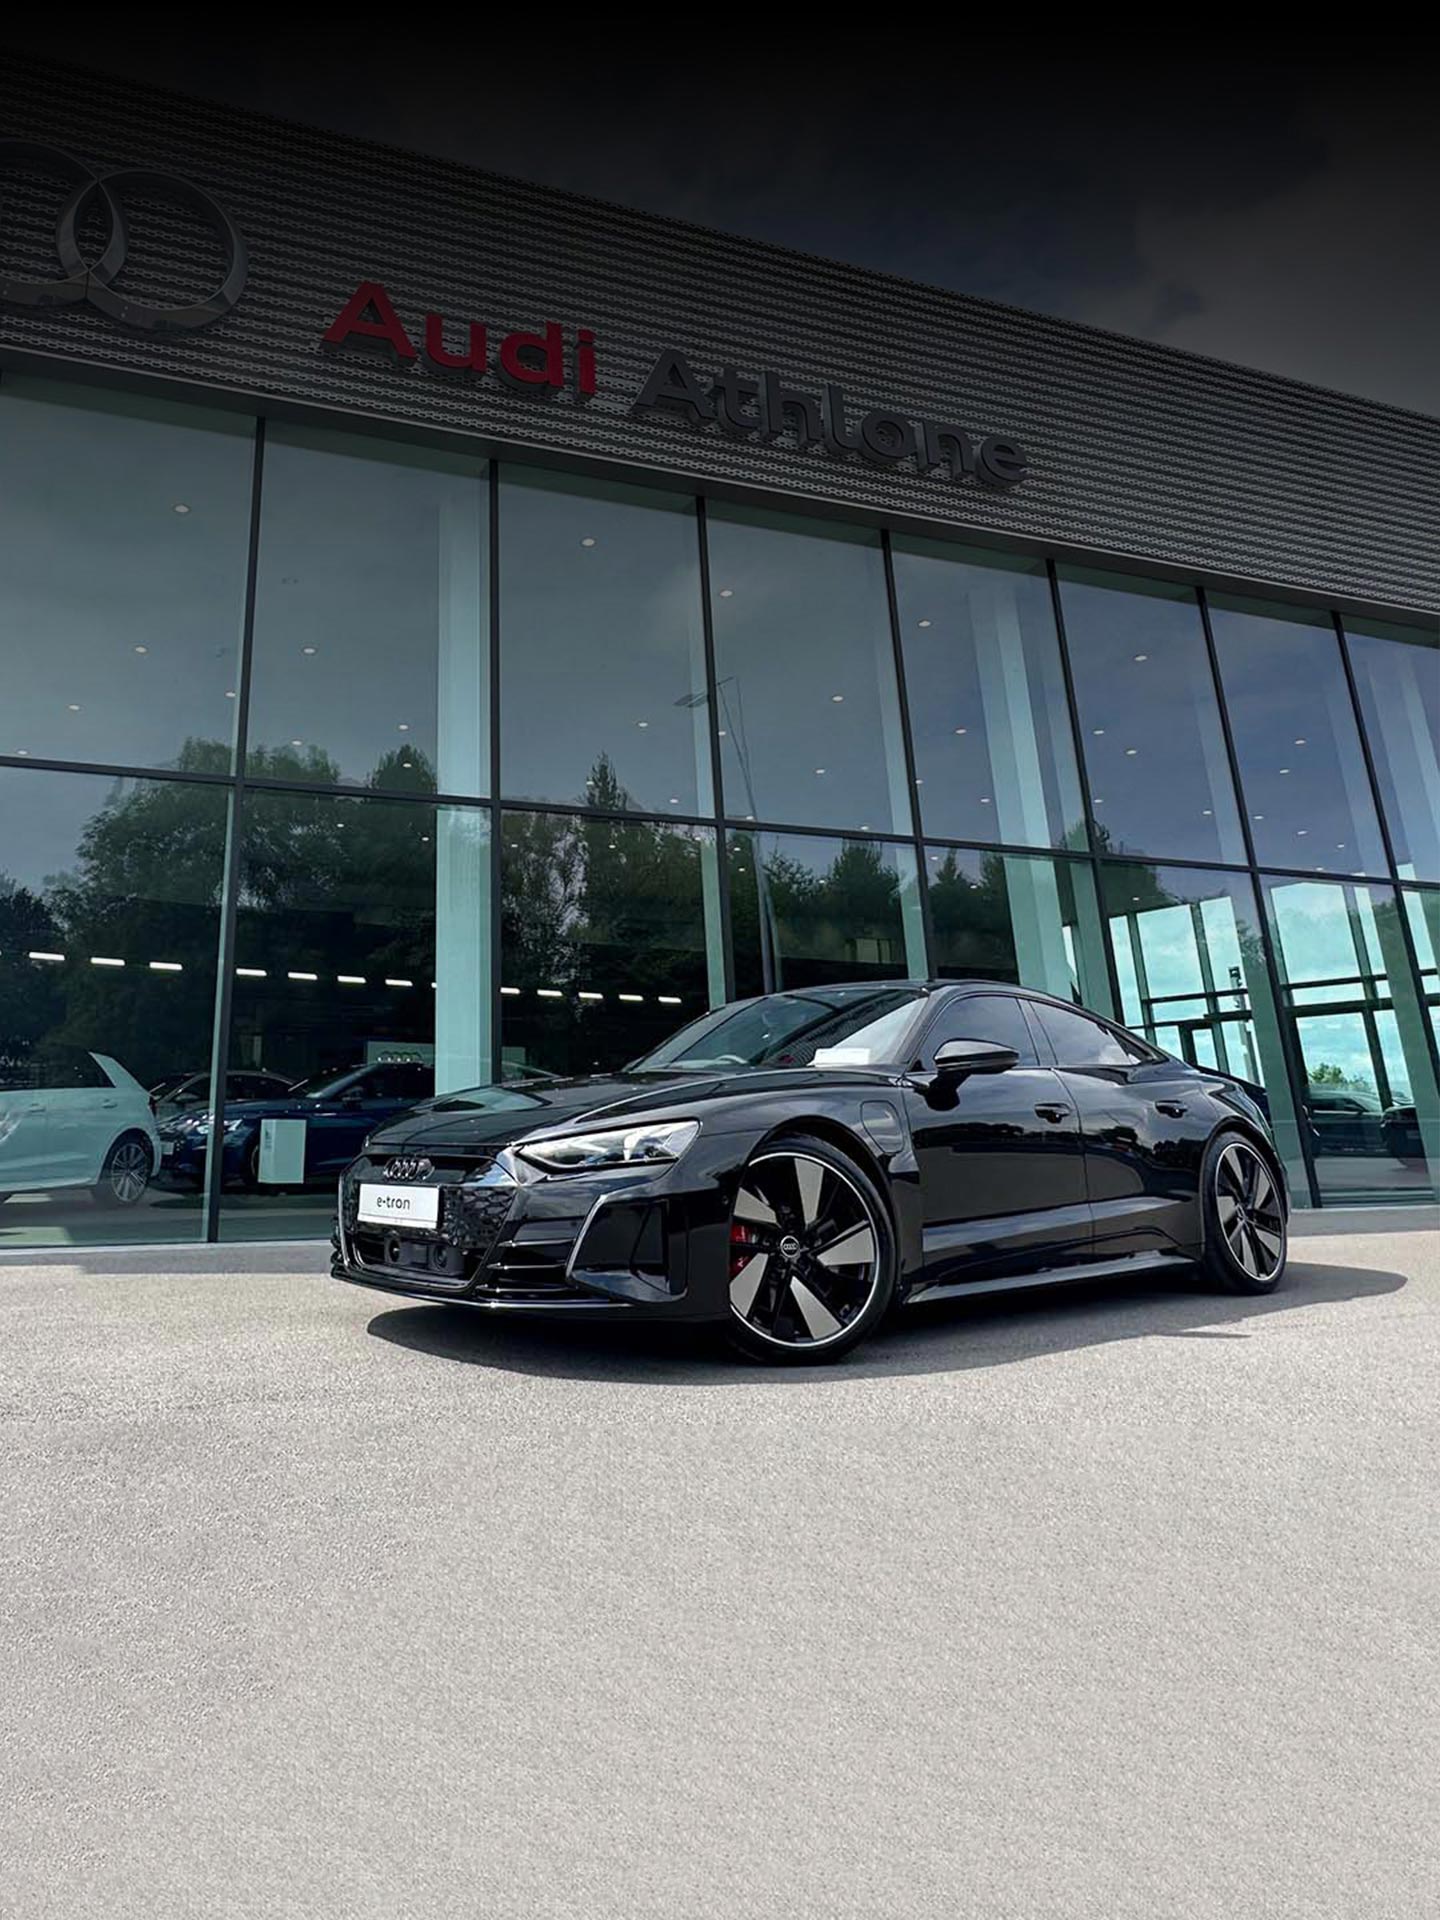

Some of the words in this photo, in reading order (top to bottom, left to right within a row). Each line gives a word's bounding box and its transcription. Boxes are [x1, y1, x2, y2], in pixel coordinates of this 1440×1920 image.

[322, 281, 597, 396] Audi
[630, 348, 1027, 488] Athlone
[376, 1196, 411, 1210] e-tron
